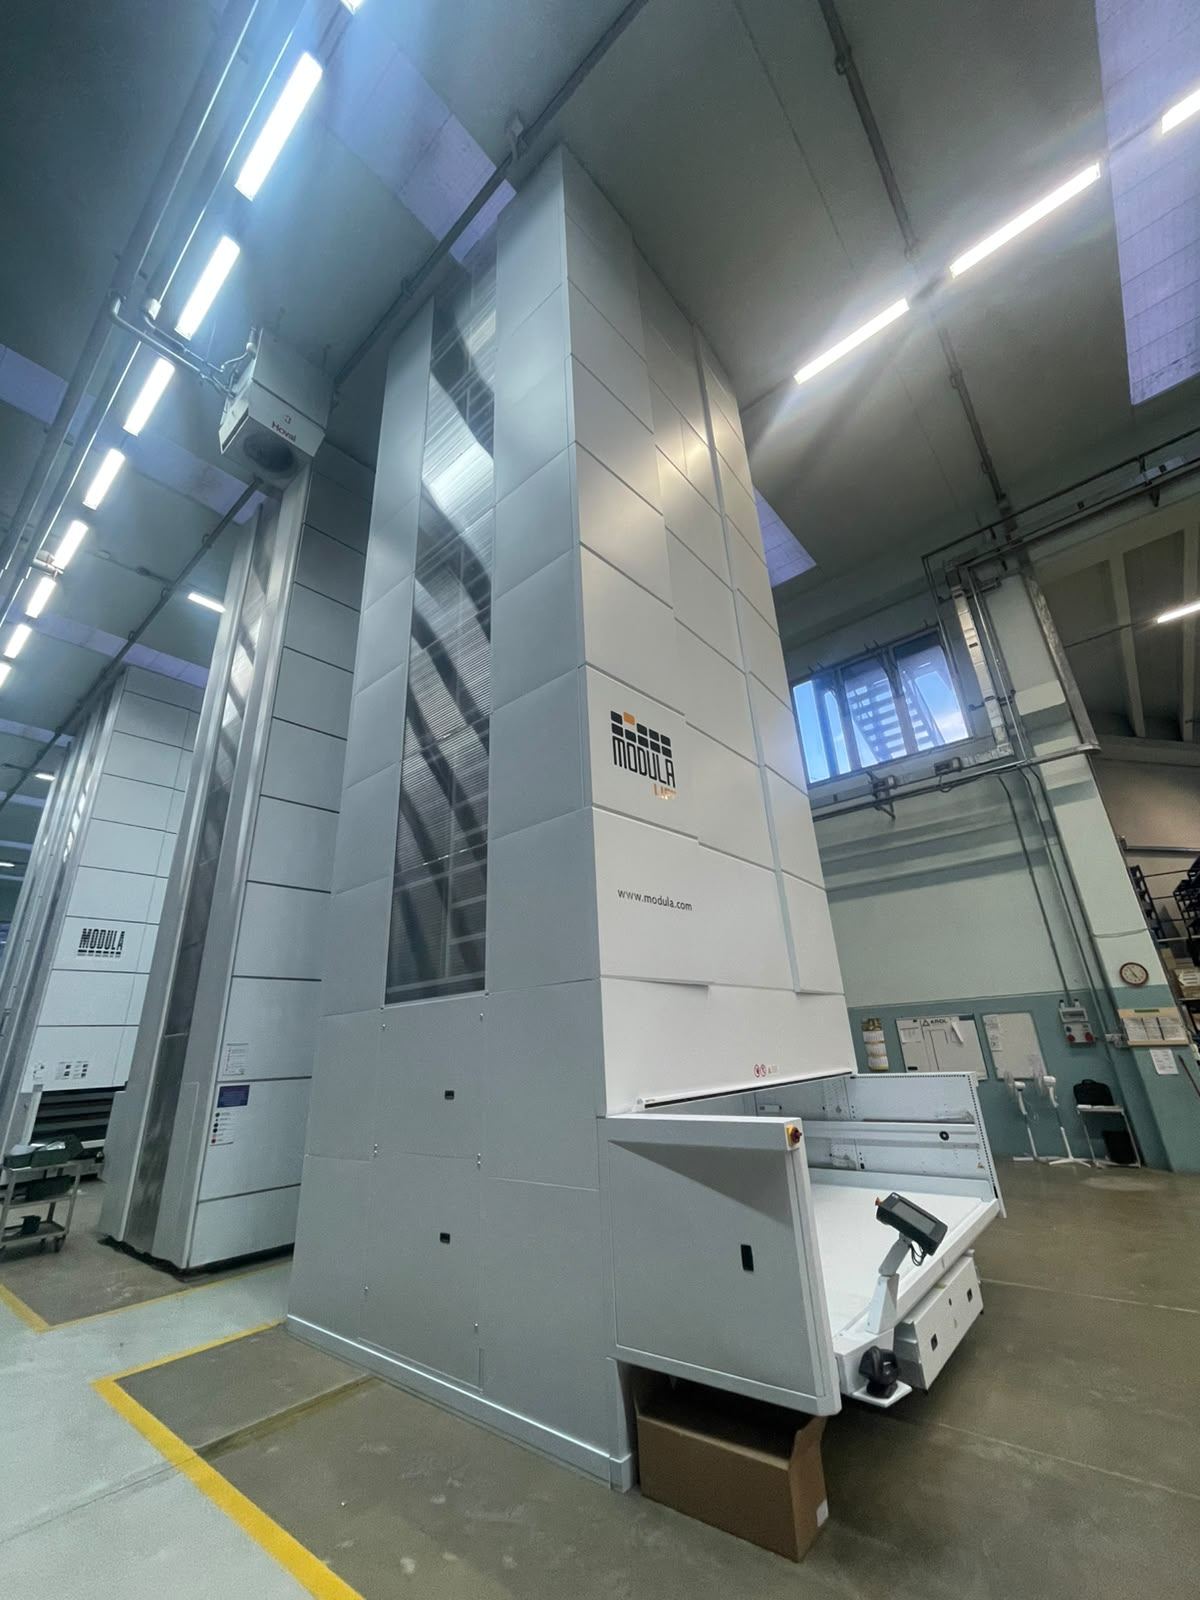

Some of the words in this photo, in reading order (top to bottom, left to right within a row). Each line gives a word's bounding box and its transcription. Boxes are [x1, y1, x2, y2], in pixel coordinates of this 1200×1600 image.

[272, 420, 297, 442] Hoval
[612, 735, 676, 788] MODULA
[617, 889, 693, 911] www.modula.com
[79, 928, 125, 951] MODULA
